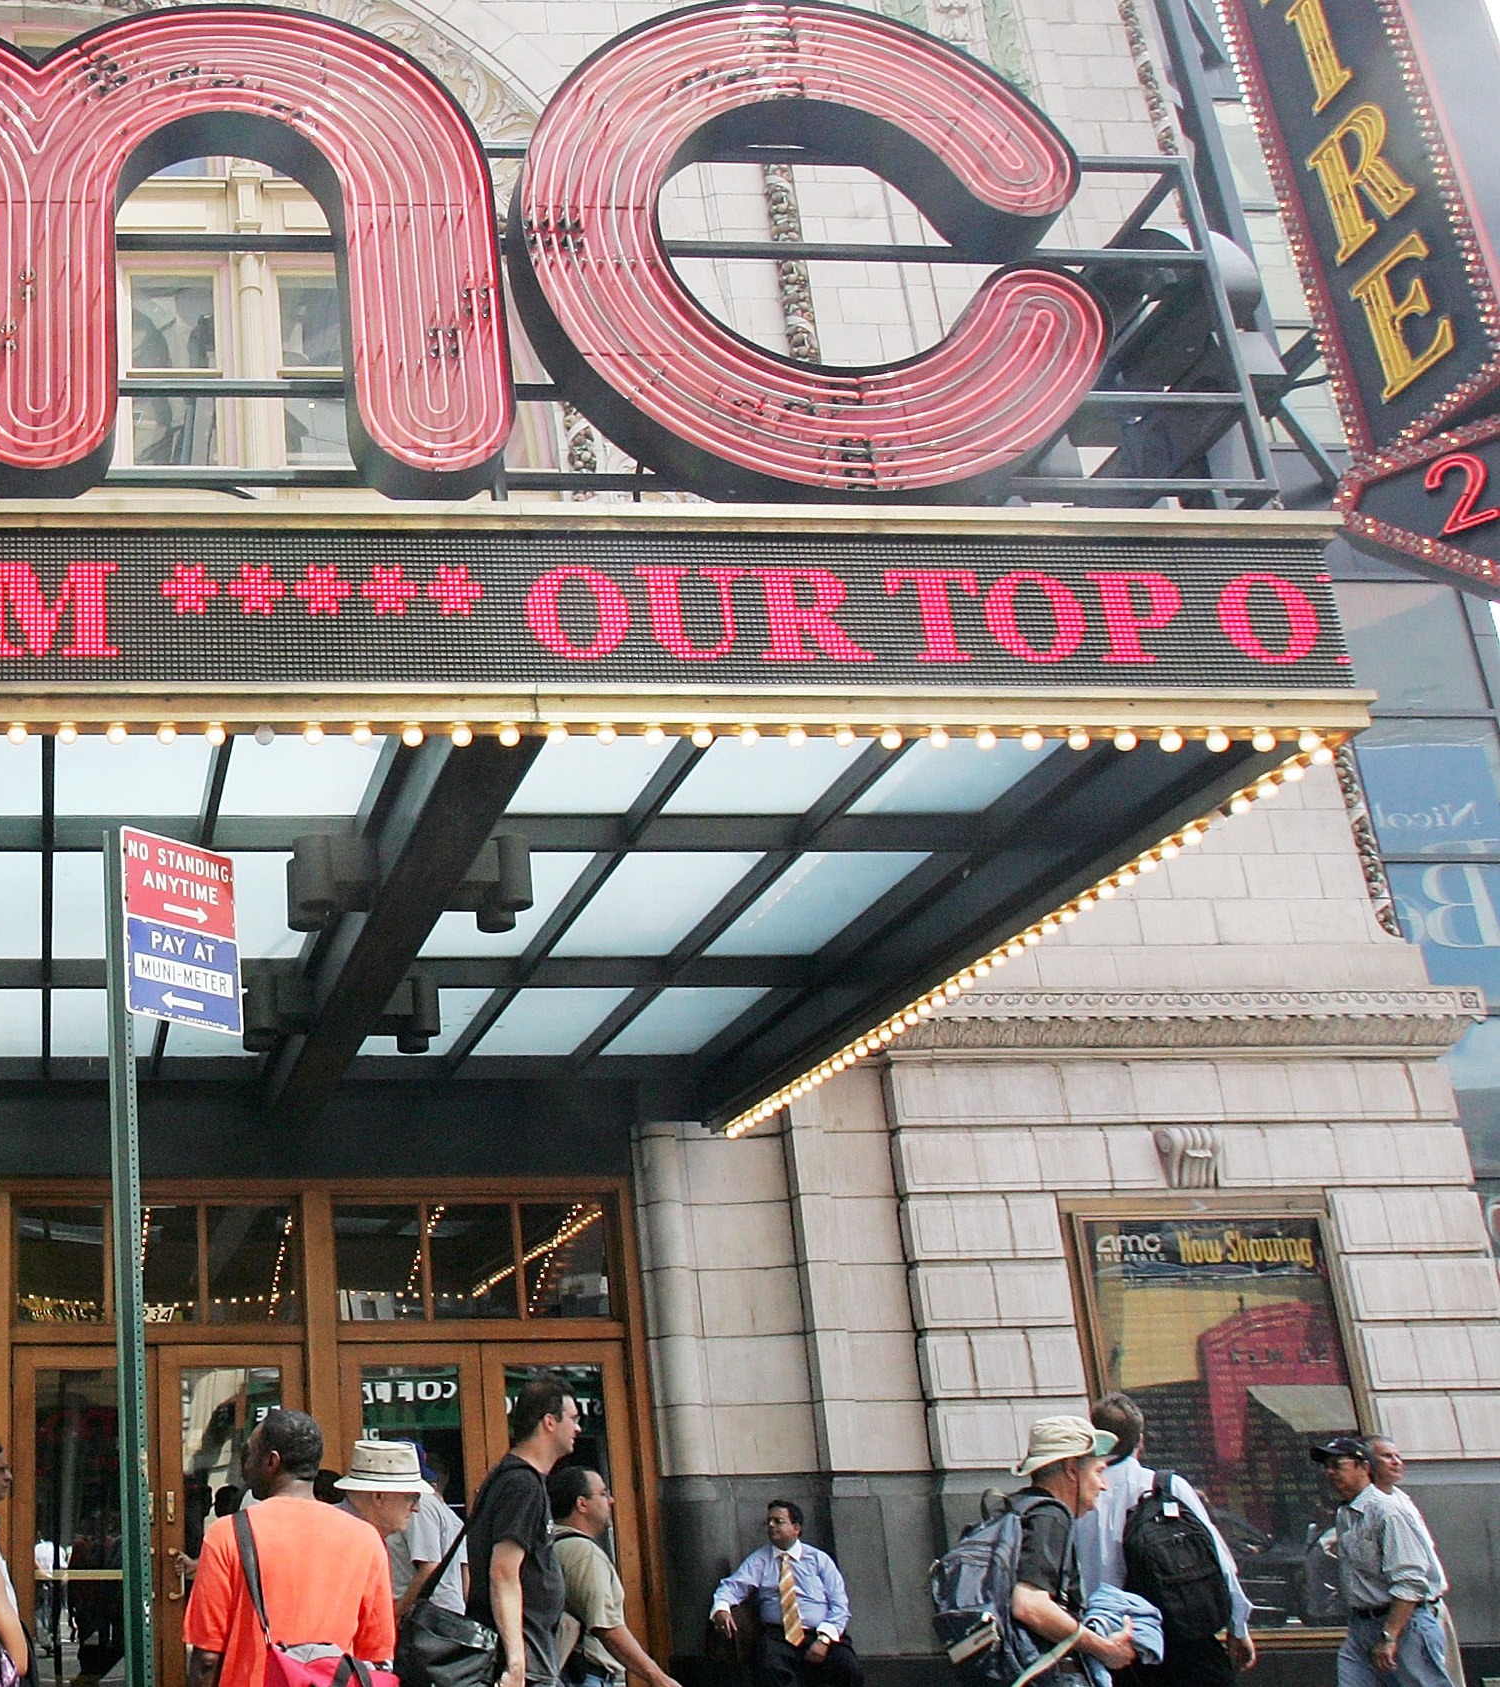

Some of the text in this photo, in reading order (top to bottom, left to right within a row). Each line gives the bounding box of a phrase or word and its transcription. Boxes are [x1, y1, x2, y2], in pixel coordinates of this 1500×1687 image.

[1260, 0, 1456, 404] IRE
[1217, 573, 1350, 666] O
[127, 839, 230, 883] NO STANDING
[142, 869, 219, 906] ANYTIME
[151, 930, 216, 963] PAY AT
[141, 957, 228, 994] MUNI-METER
[1177, 1230, 1223, 1264] Now
[1224, 1230, 1315, 1268] Showing
